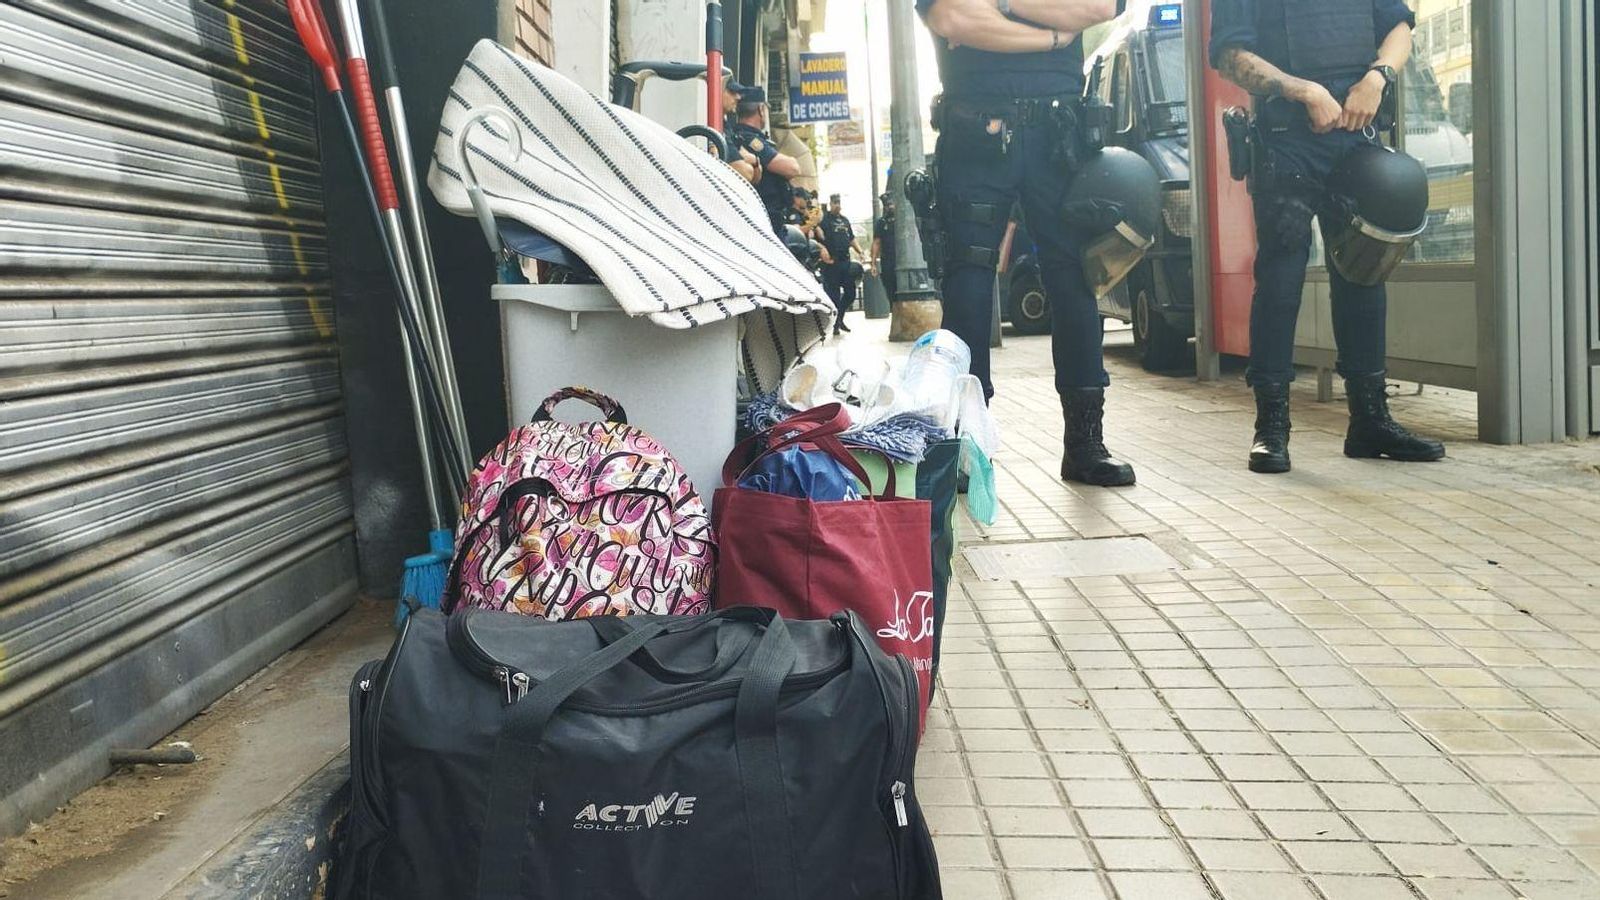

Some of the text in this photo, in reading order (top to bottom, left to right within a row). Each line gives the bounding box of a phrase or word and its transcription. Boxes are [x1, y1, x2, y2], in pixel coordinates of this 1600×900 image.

[800, 57, 846, 73] LAVADERO
[801, 79, 847, 96] MANUAL
[793, 101, 849, 119] DE COCHES
[575, 791, 697, 828] ACTIVE
